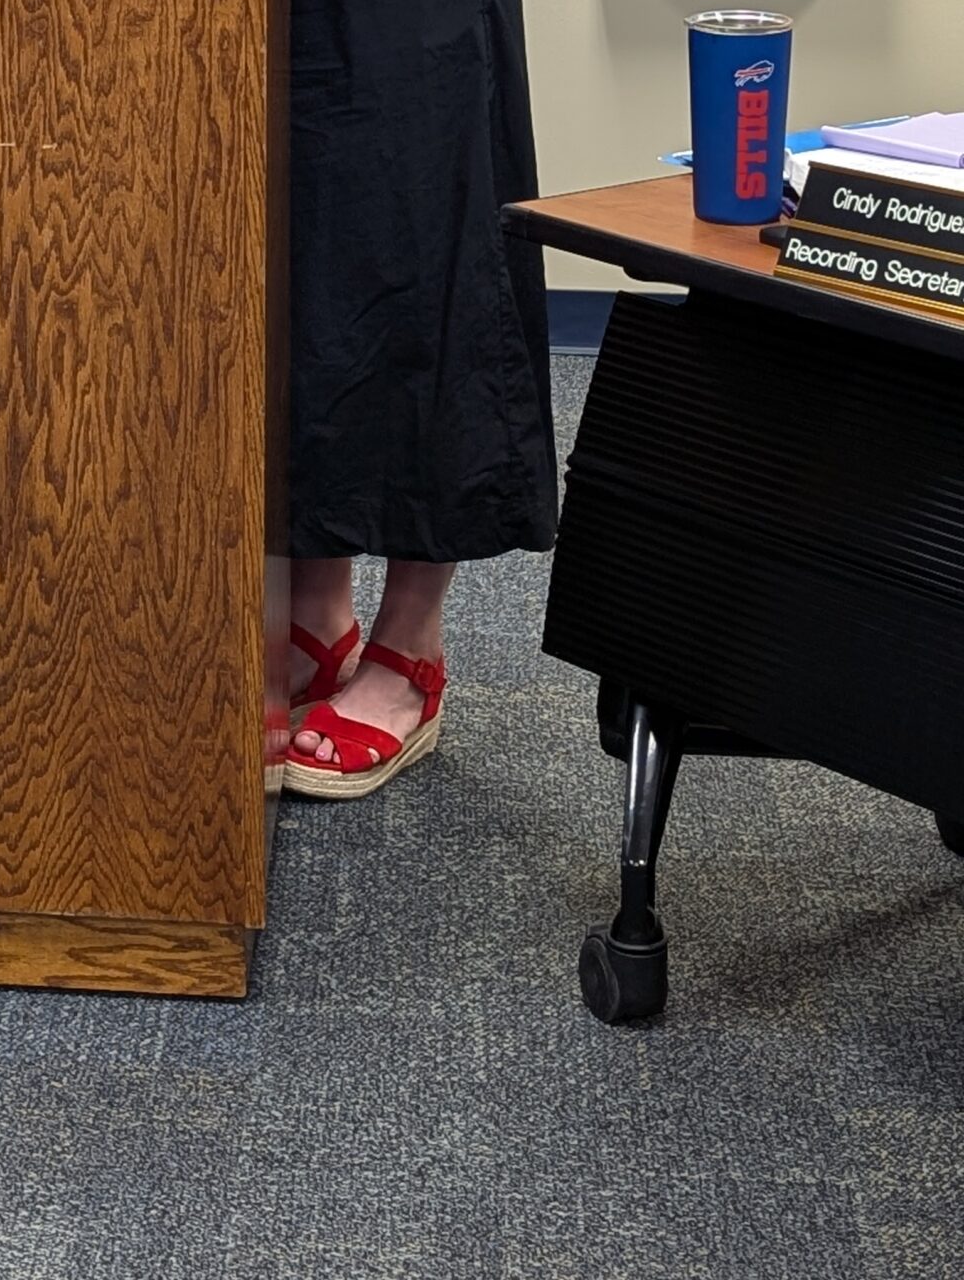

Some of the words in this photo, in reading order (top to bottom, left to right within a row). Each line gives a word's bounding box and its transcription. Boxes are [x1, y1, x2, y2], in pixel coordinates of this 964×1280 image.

[736, 89, 769, 199] BILLS
[833, 187, 882, 219] Cindy
[785, 238, 878, 282] Recording
[884, 260, 964, 303] Secretar
